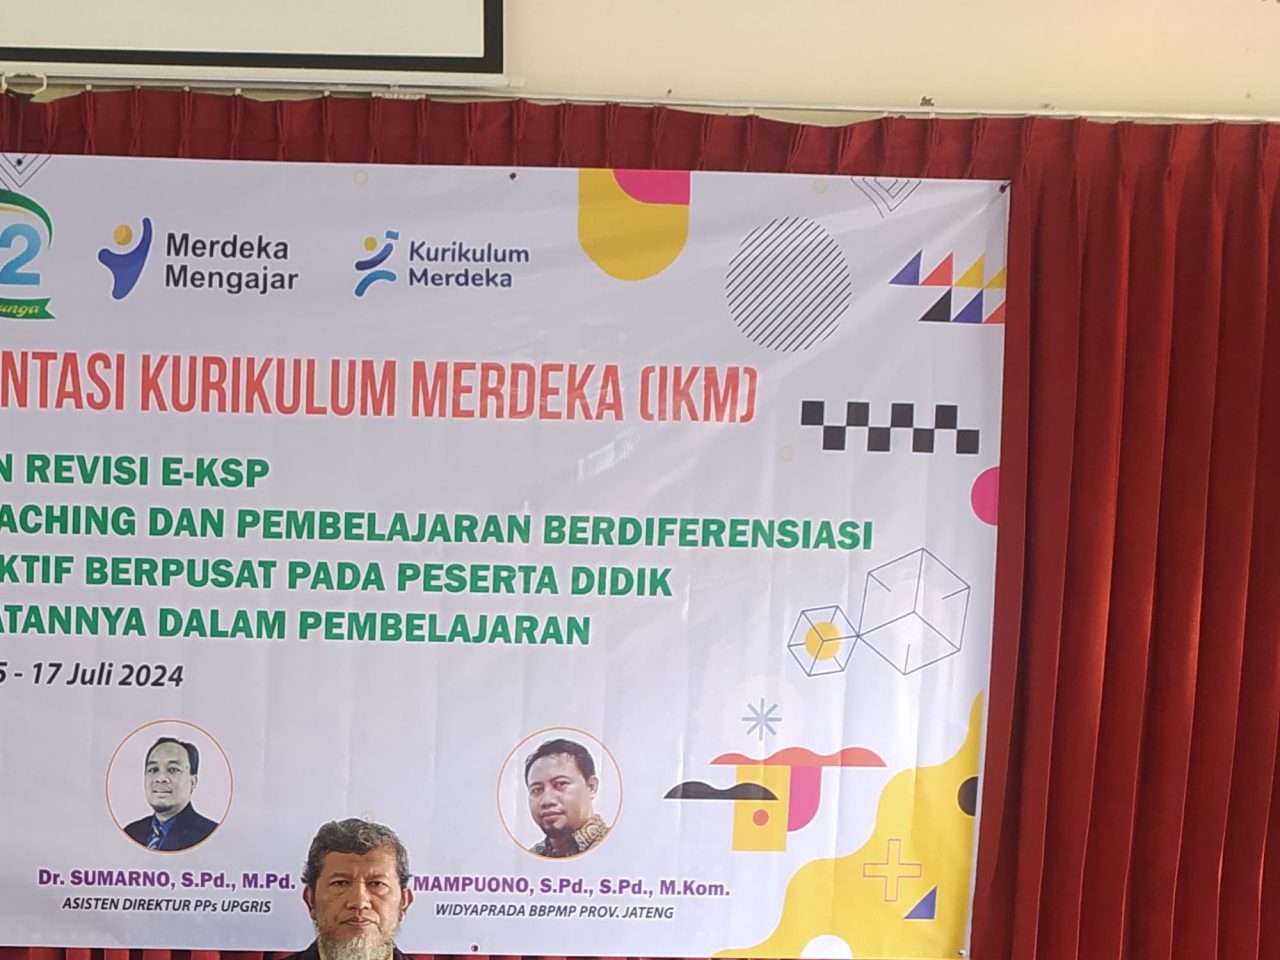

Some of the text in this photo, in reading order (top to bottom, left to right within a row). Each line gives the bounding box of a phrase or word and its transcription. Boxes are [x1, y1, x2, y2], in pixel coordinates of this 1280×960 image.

[166, 232, 288, 260] Merdeka
[409, 241, 529, 263] Kurikulum
[165, 264, 299, 295] Mengajar
[409, 267, 512, 288] Merdeka
[140, 353, 397, 417] KURIKULUM
[411, 360, 624, 421] MERDEKA
[639, 365, 758, 424] (IKM)
[26, 453, 149, 486] REVISI
[161, 456, 270, 489] E-KSP
[148, 506, 225, 539] DAN
[236, 508, 532, 545] PEMBELAJARAN
[543, 514, 873, 550] BERDIFERENSIASI
[85, 556, 277, 589] BERPUSAT
[287, 560, 385, 593] PADA
[397, 562, 559, 594] PESERTA
[571, 565, 673, 598] DIDIK
[158, 607, 287, 640] DALAM
[298, 610, 591, 646] PEMBELAJARAN
[33, 662, 63, 685] 17
[66, 661, 114, 686] Juli
[118, 664, 184, 687] 2024
[37, 868, 296, 891] Dr. SUMARNO, S.Pd., M.Pd.
[413, 875, 731, 898] MAMPUONO, S.Pd., S.Pd., M.Kom.
[61, 897, 271, 913] ASISTEN DIREKTUR PPs UPGRIS
[435, 903, 675, 920] WIDYAPRADA BBPMP PROV. JATENG
